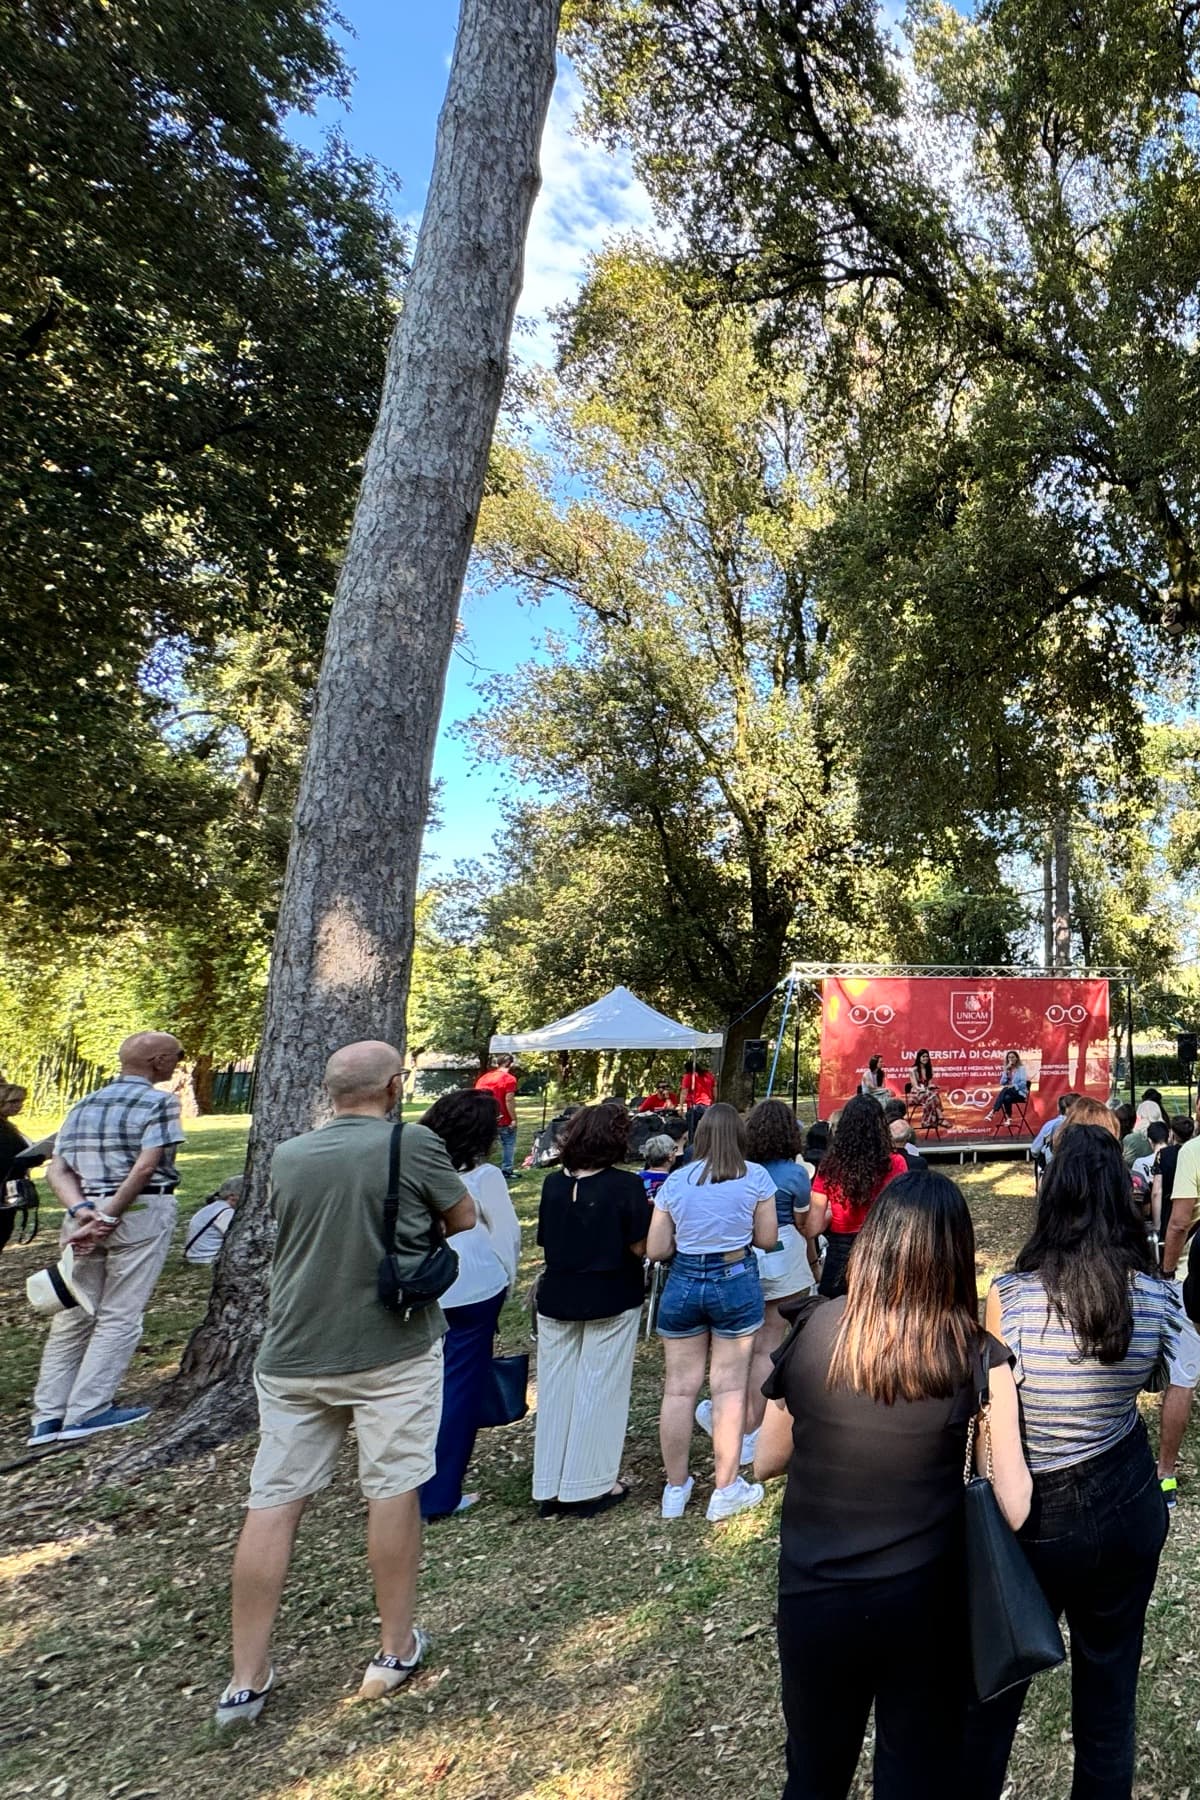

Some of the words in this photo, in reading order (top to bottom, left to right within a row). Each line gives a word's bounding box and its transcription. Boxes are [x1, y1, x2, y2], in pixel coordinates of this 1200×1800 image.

[957, 1011, 988, 1020] UNICAM
[901, 1048, 966, 1060] UNERSITÀ
[969, 1049, 979, 1060] DI
[234, 1690, 250, 1704] 19
